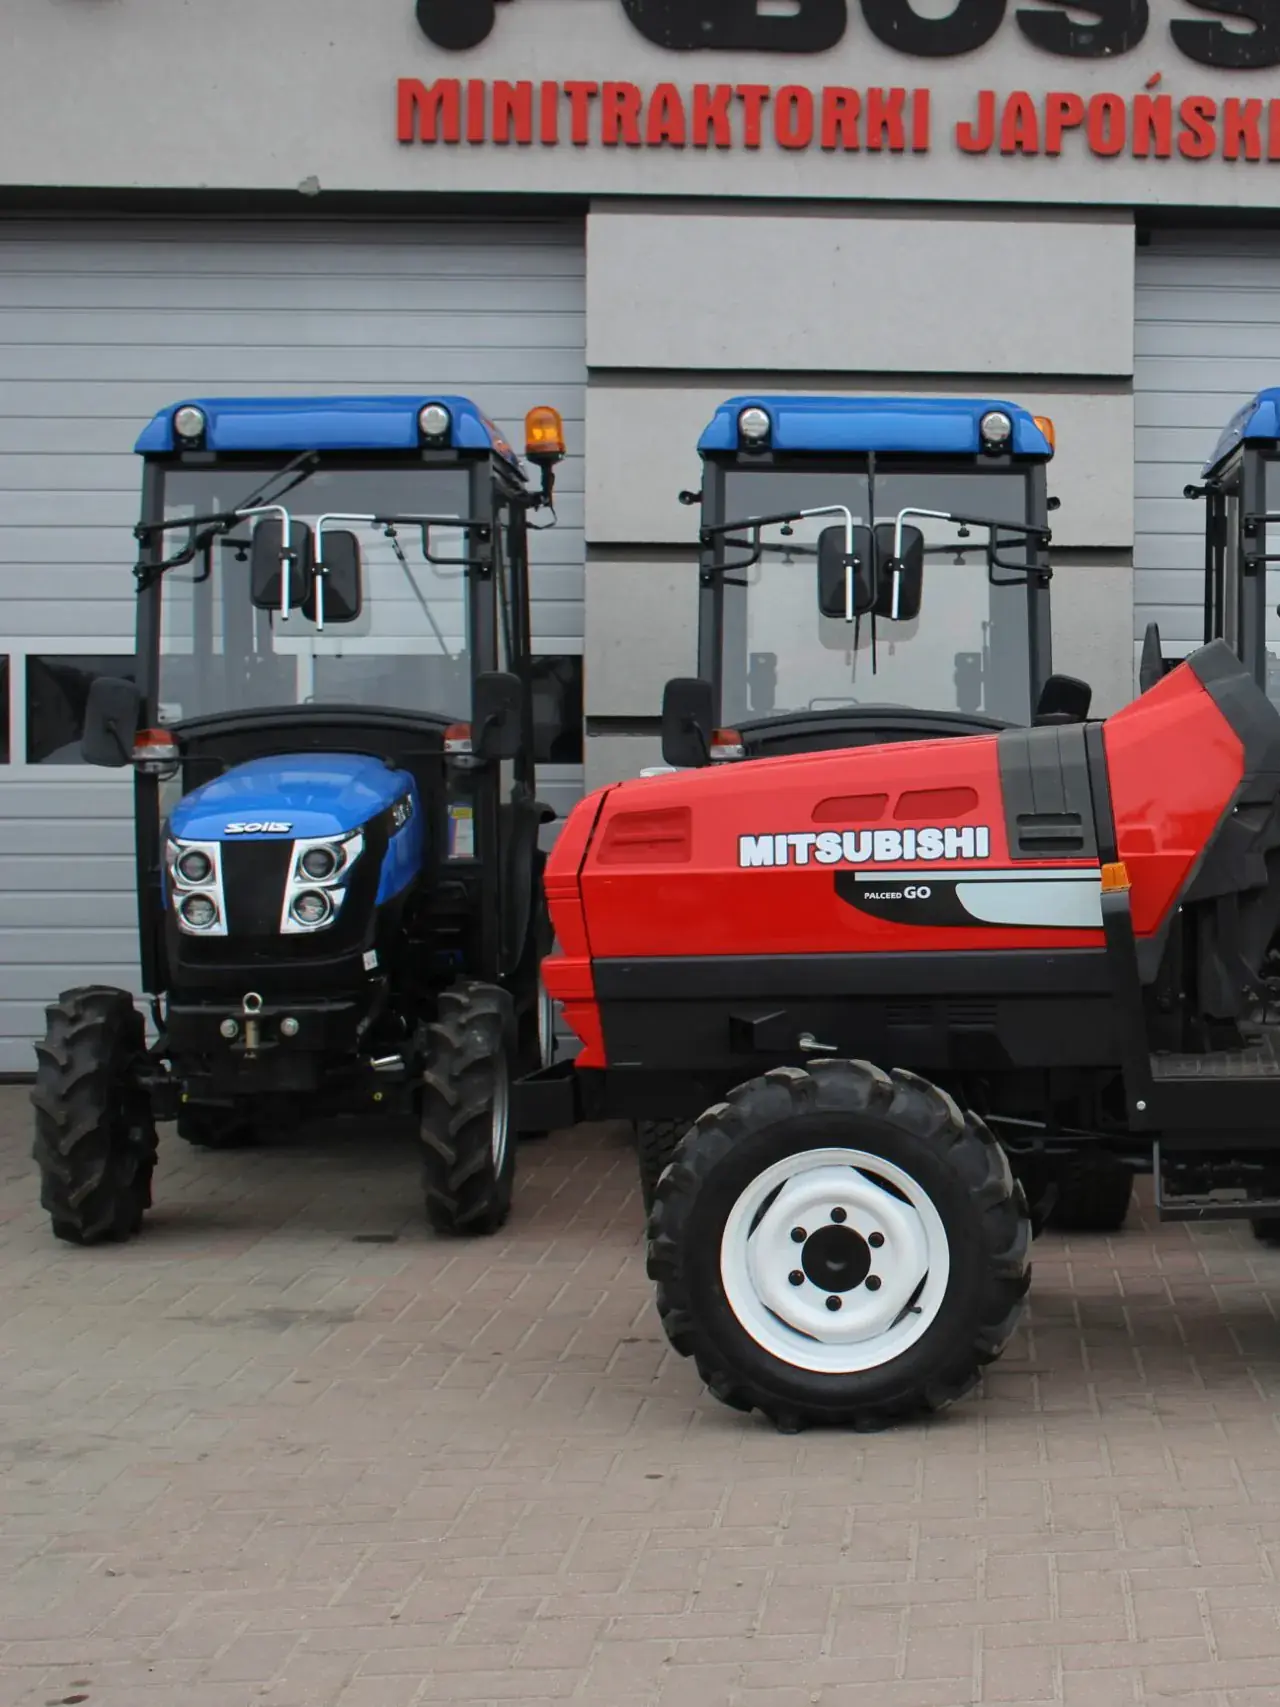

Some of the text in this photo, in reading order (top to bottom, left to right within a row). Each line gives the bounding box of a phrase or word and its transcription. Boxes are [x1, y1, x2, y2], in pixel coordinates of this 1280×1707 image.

[397, 78, 930, 154] MINITRAKTORKI
[738, 826, 990, 867] MITSUBISHI
[864, 886, 931, 900] PALCEED GO
